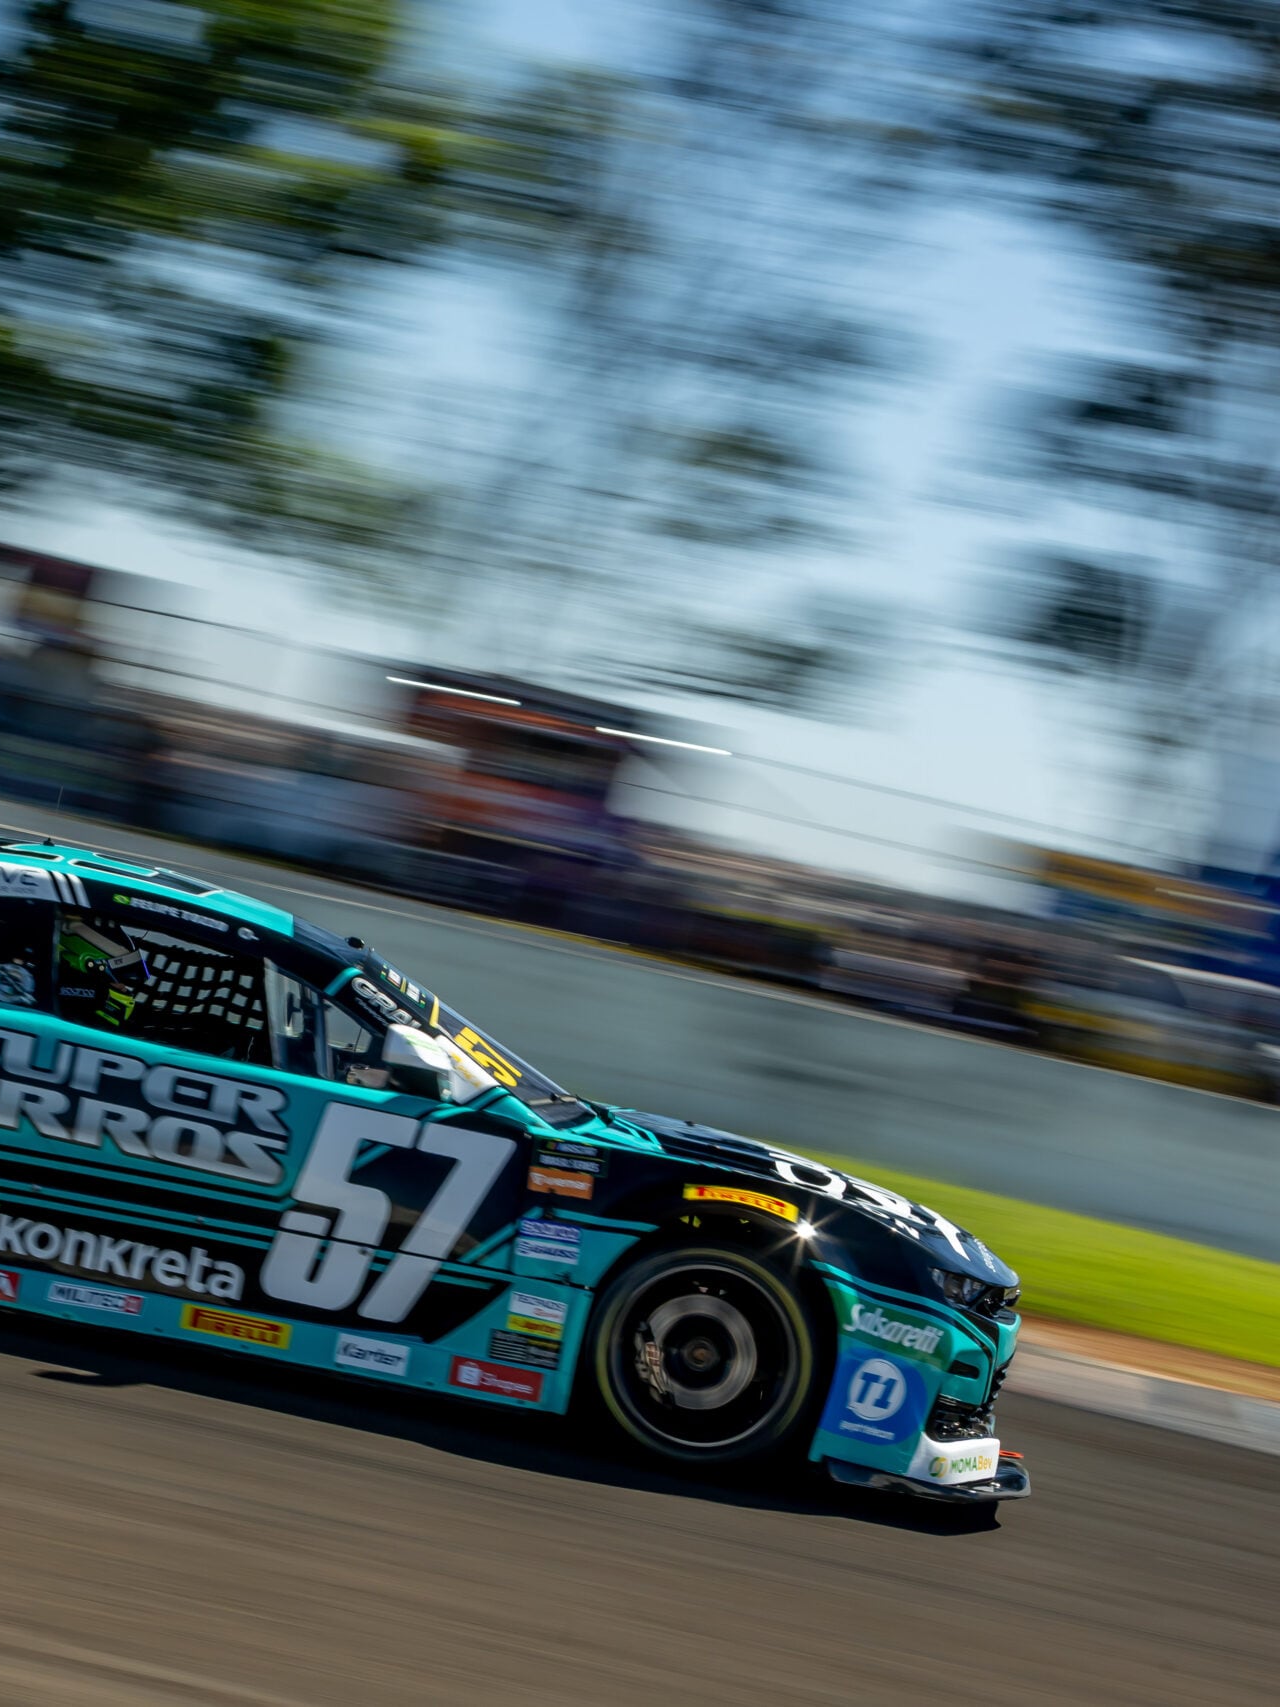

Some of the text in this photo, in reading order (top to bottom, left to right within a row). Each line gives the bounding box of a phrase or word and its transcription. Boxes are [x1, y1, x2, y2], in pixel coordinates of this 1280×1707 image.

[260, 1101, 517, 1323] 57
[697, 1186, 786, 1216] PIRELLI
[192, 1307, 283, 1346] PIRELLI
[854, 1371, 898, 1410] T1
